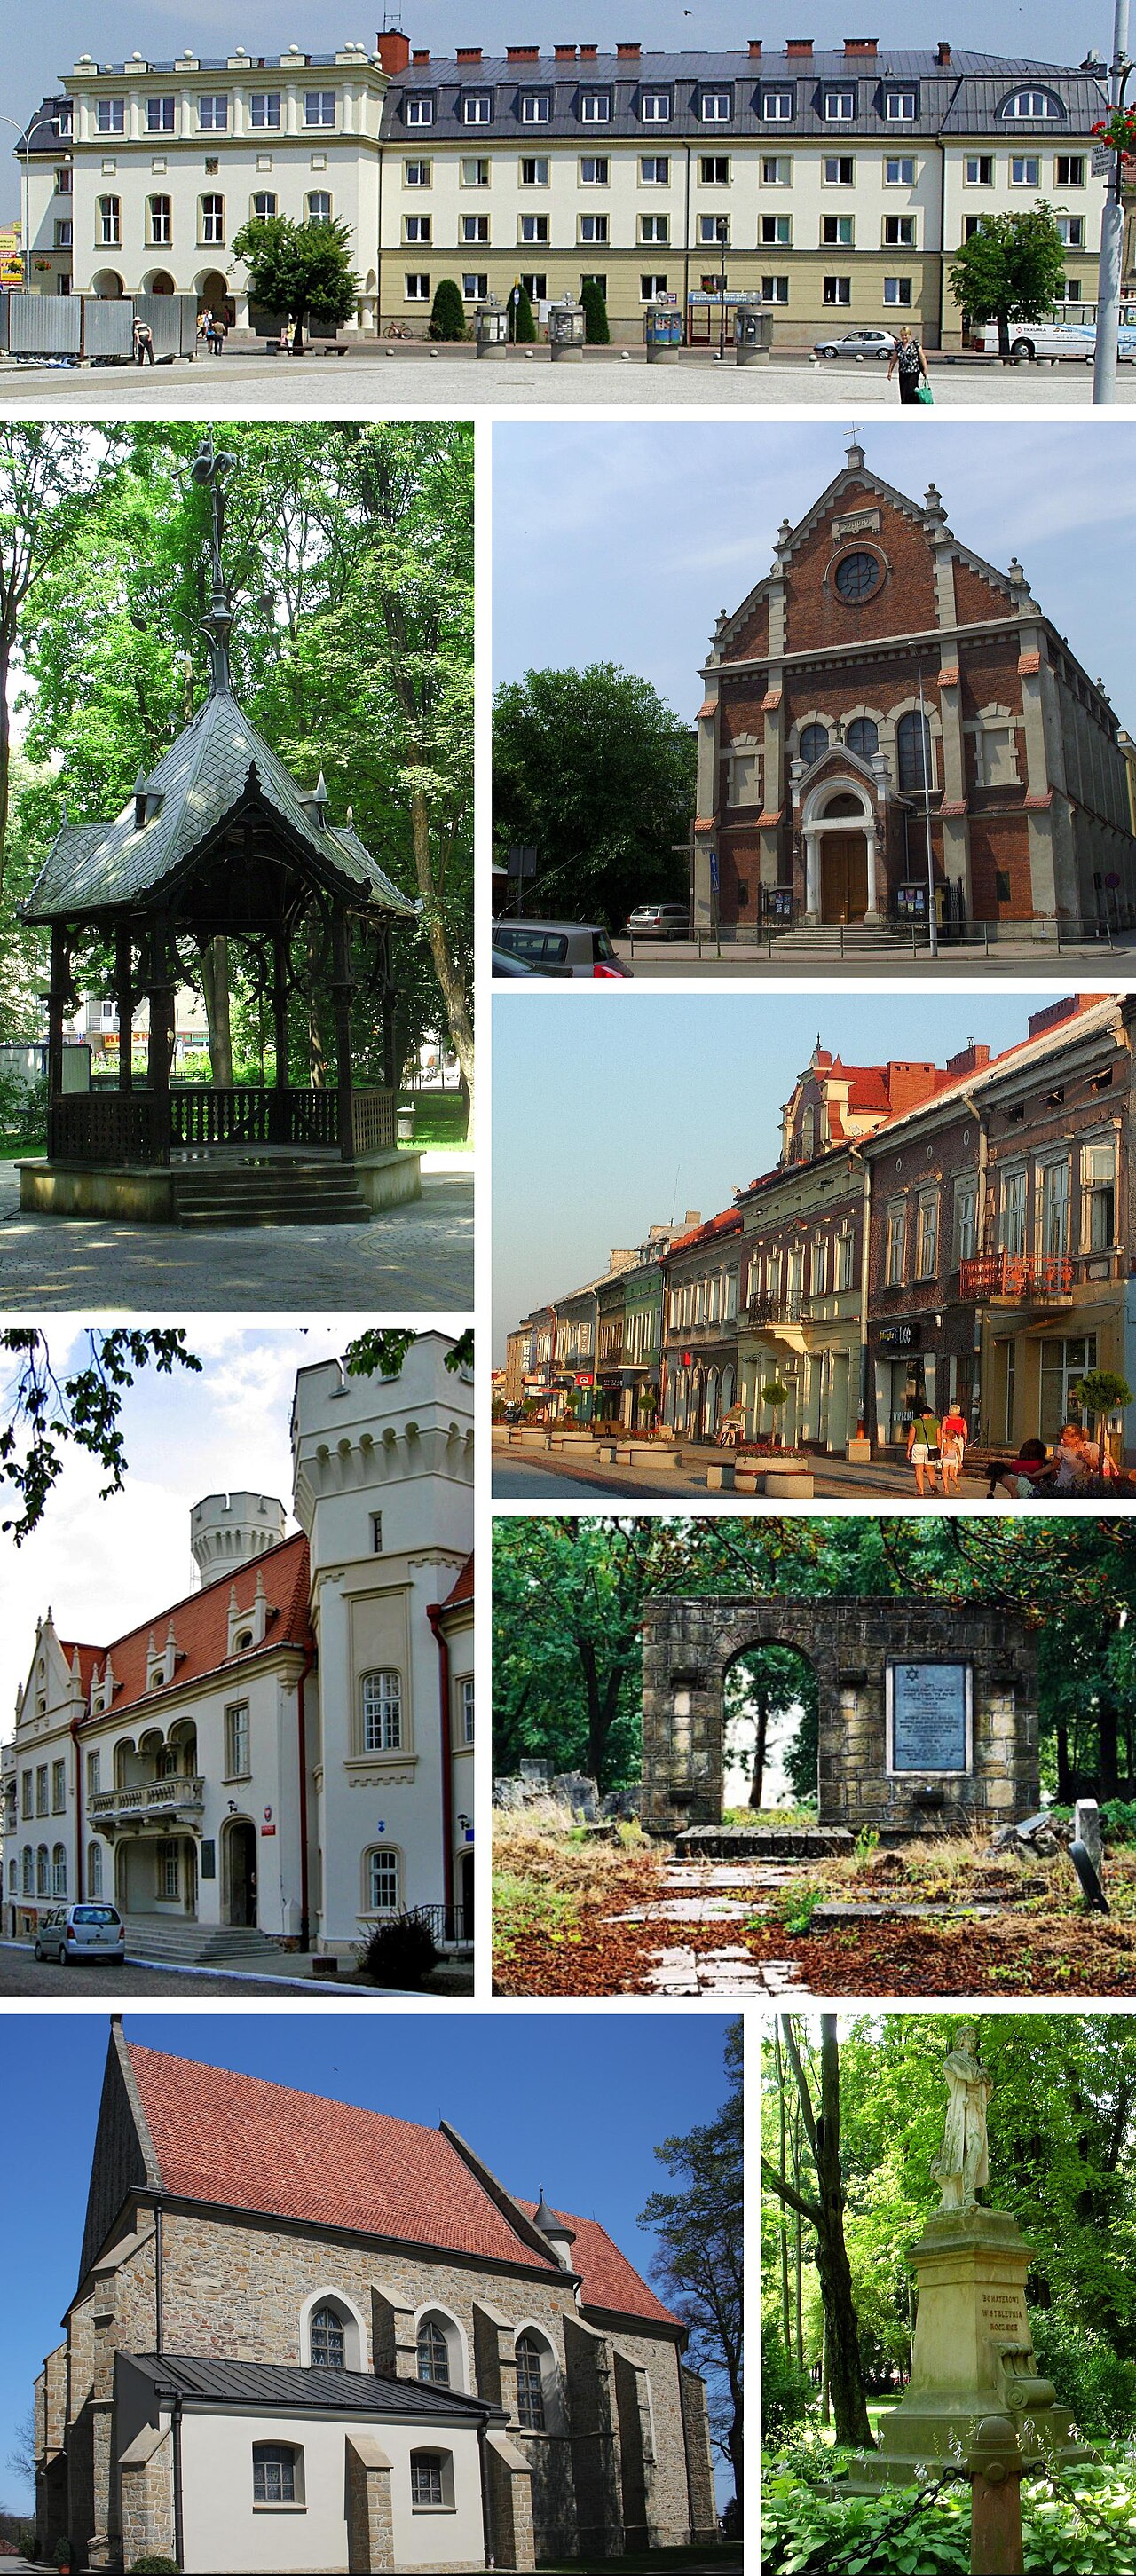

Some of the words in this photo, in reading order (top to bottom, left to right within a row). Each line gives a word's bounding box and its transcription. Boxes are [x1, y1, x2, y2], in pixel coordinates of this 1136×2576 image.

[106, 1033, 149, 1043] KISK
[899, 1326, 911, 1344] Lee
[982, 2295, 1019, 2304] BOHATEROWI
